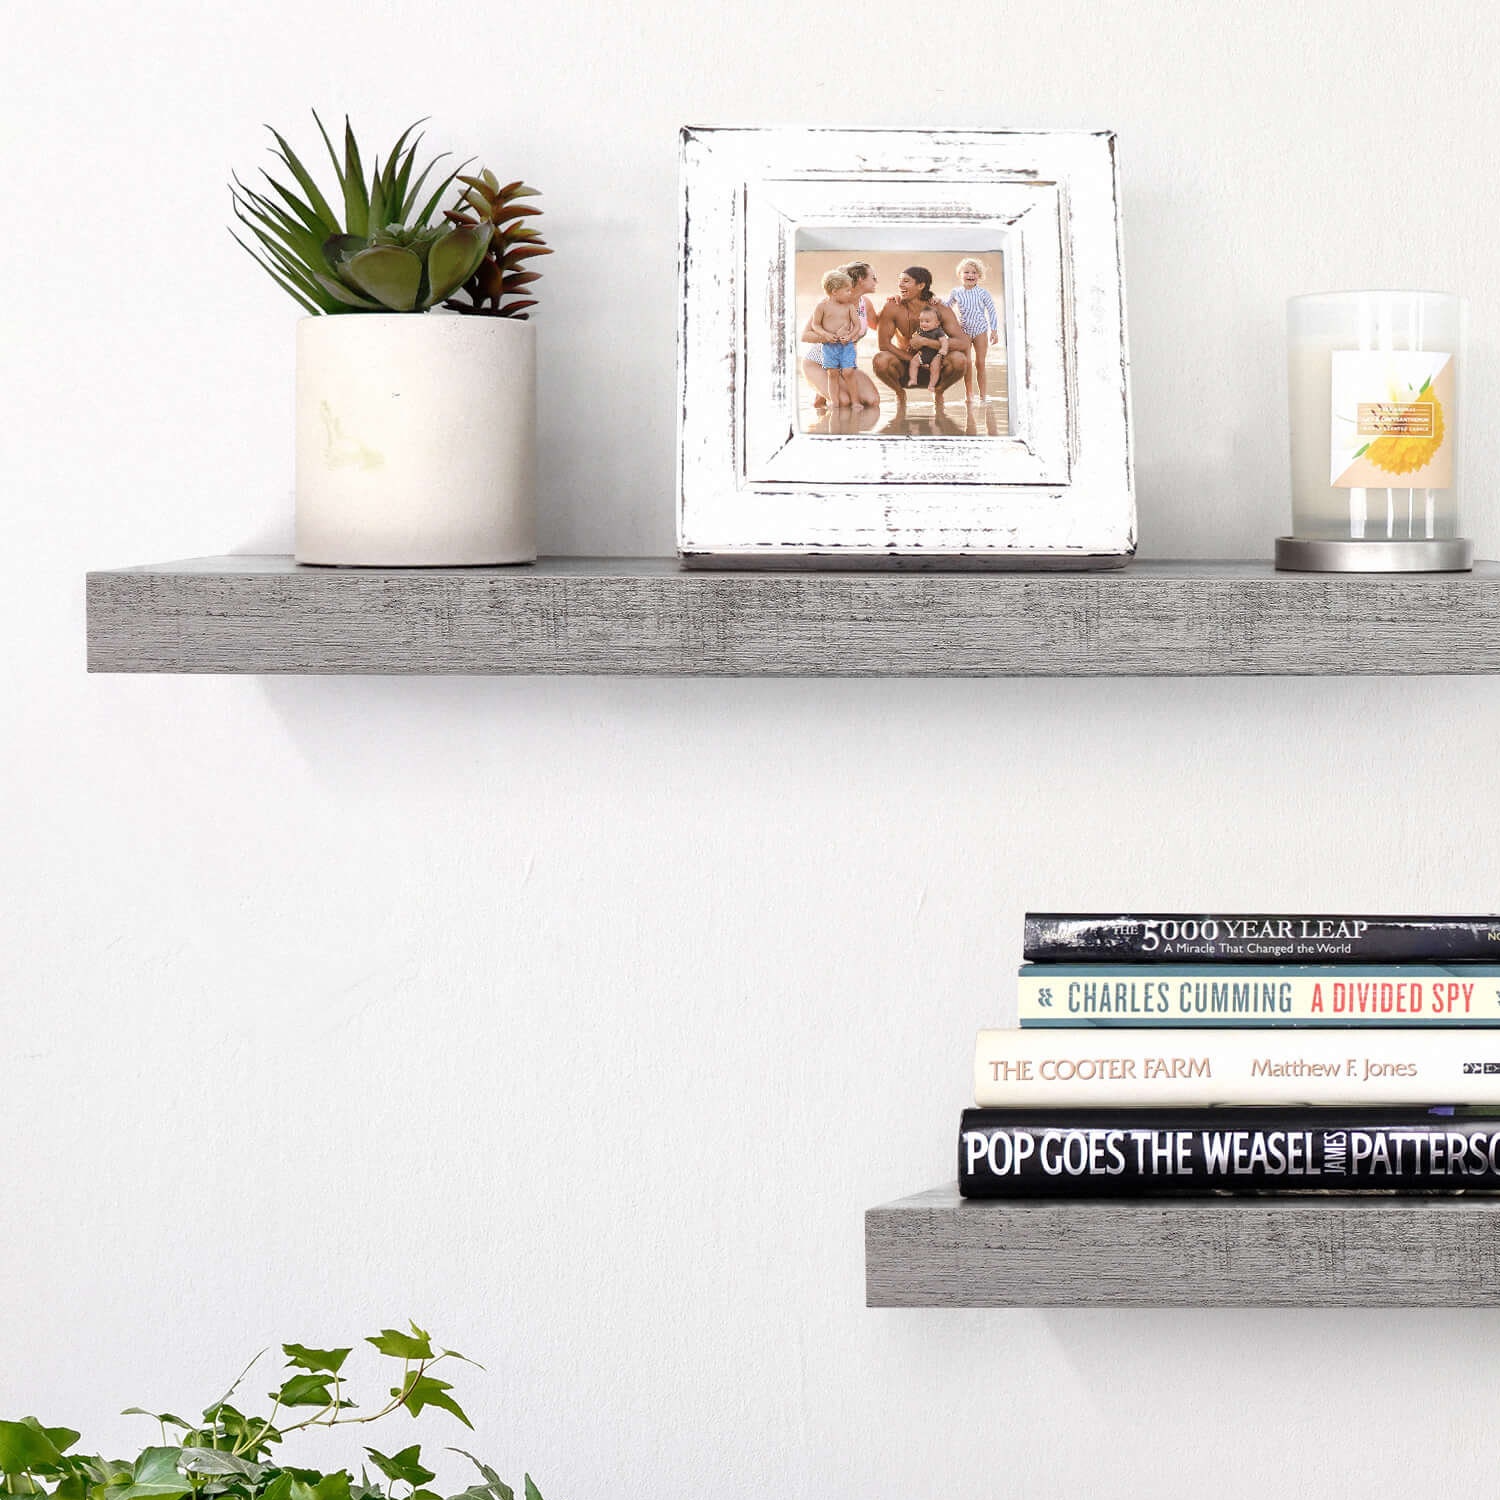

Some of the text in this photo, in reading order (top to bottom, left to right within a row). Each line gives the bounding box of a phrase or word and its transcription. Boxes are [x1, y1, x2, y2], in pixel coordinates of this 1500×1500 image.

[1113, 919, 1369, 951] THE 5000 YEAR LEAP
[1164, 943, 1351, 956] A Miracle That Changed the World
[1068, 982, 1293, 1013] CHARLES CUMMING
[1311, 982, 1475, 1013] A DIVIDED SPY
[988, 1057, 1212, 1081] THE COOTER FARM
[1251, 1058, 1418, 1082] Matthew F. Jones
[964, 1131, 1321, 1175] POP GOES THE WEASEL
[1323, 1131, 1348, 1176] JAMES
